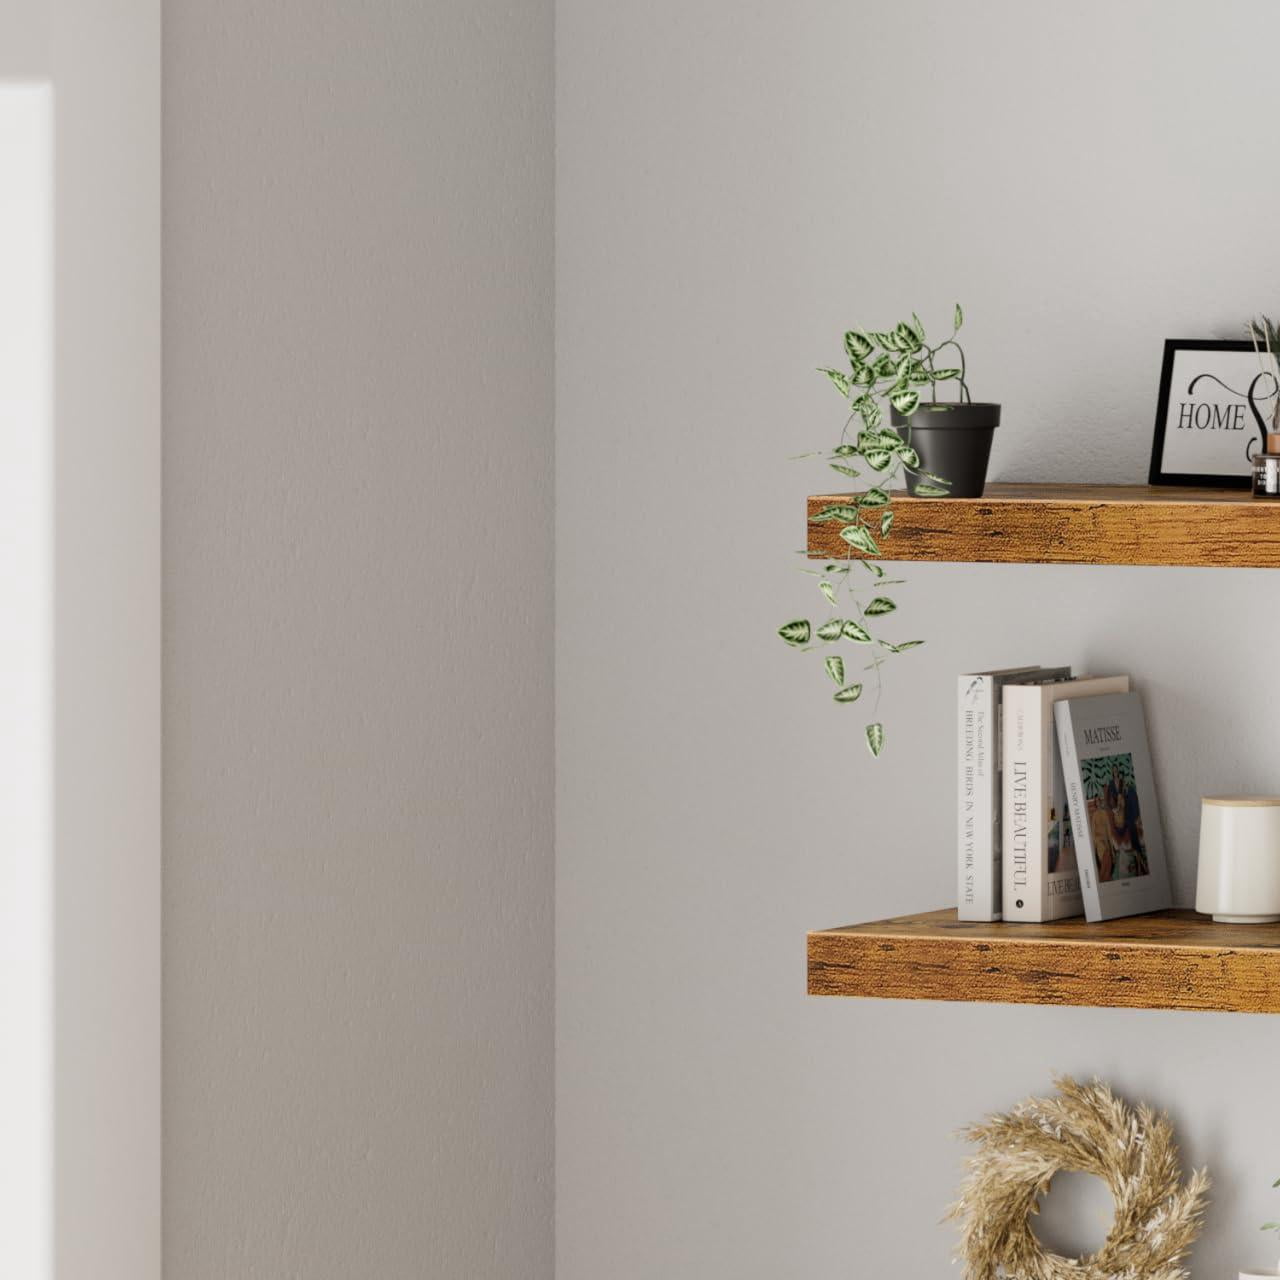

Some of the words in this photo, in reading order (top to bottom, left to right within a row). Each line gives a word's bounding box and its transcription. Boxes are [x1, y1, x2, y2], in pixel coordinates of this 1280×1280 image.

[1177, 402, 1247, 431] HOME
[1083, 725, 1122, 745] MATISSE
[965, 766, 974, 797] BIRDS
[1013, 761, 1027, 800] LIVE
[965, 841, 974, 869] YORK
[1013, 802, 1027, 891] BEAUTIFUL
[965, 874, 974, 905] STATE
